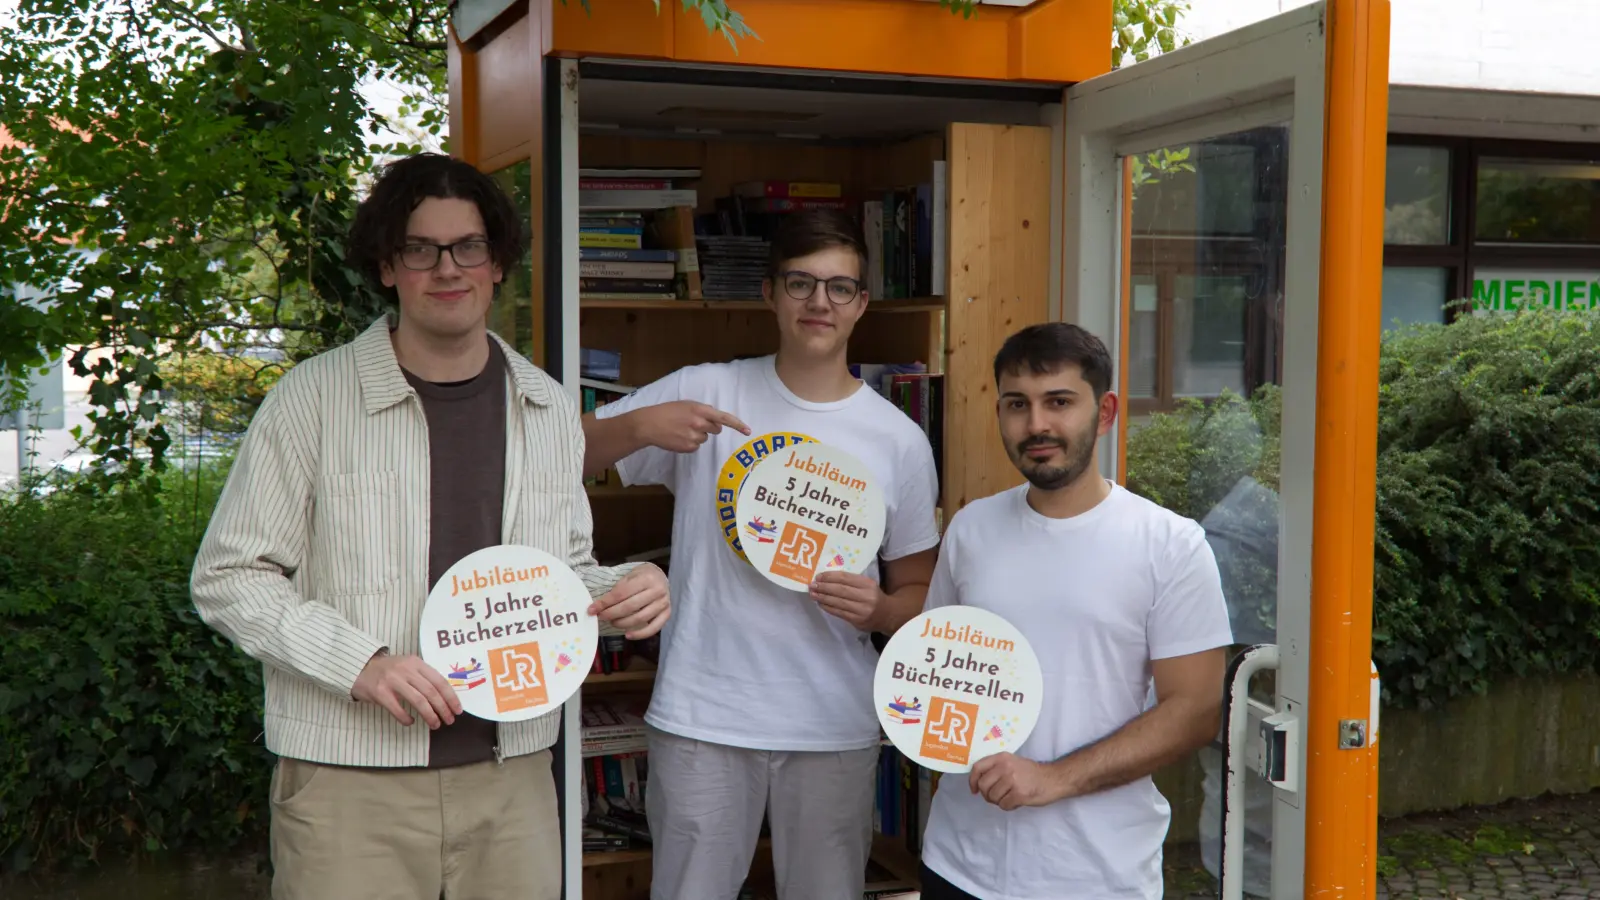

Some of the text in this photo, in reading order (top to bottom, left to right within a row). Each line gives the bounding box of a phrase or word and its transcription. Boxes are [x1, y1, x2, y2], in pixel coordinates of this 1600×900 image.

[735, 435, 813, 469] BART
[784, 450, 867, 492] Jubiläum
[785, 476, 850, 511] 5 Jahre
[754, 485, 868, 539] Bücherzellen
[451, 565, 549, 597] Jubiläum
[464, 592, 544, 620] 5 Jahre
[436, 609, 579, 649] Bücherzellen
[920, 618, 1015, 652] Jubiläum
[924, 647, 1000, 676] 5 Jahre
[891, 661, 1025, 704] Bücherzellen
